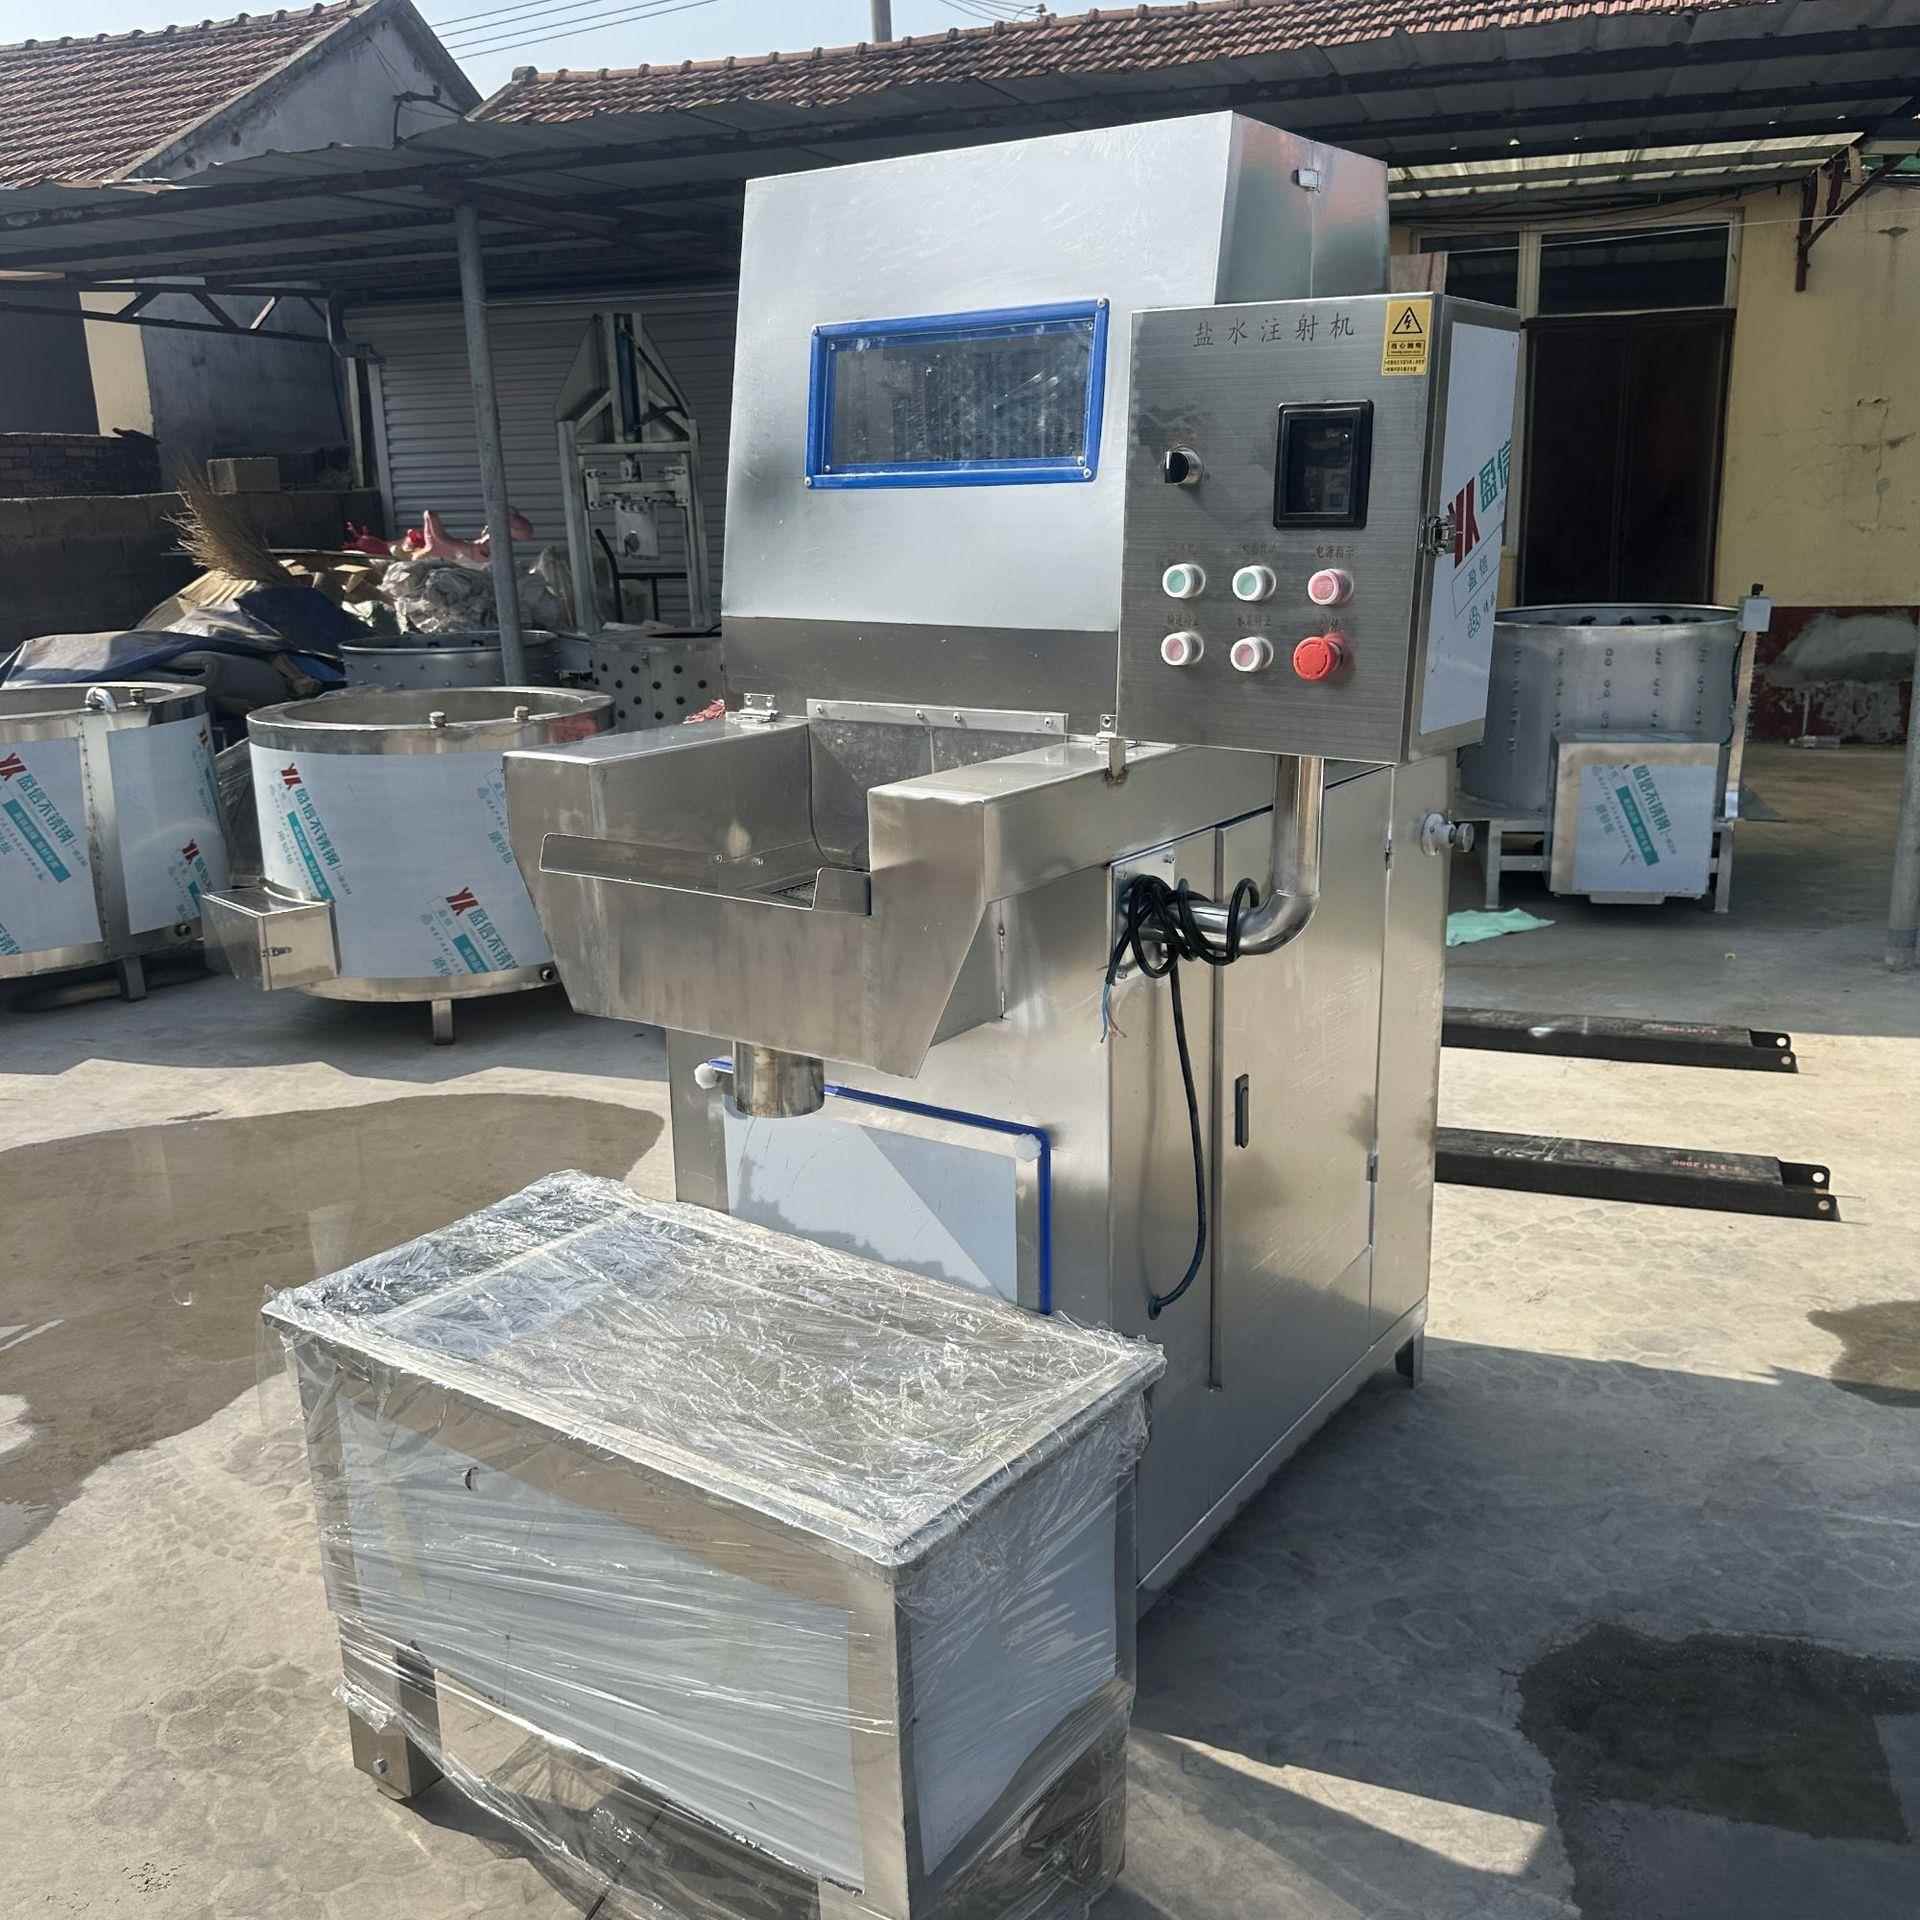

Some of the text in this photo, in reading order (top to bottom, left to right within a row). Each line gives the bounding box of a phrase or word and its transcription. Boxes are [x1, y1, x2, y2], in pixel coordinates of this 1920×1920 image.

[1193, 311, 1354, 348] 盐水注射机
[17, 772, 75, 843] 盈信不锈钢
[294, 787, 341, 867] 盈信不锈钢
[1632, 764, 1672, 832] 盈信不锈钢
